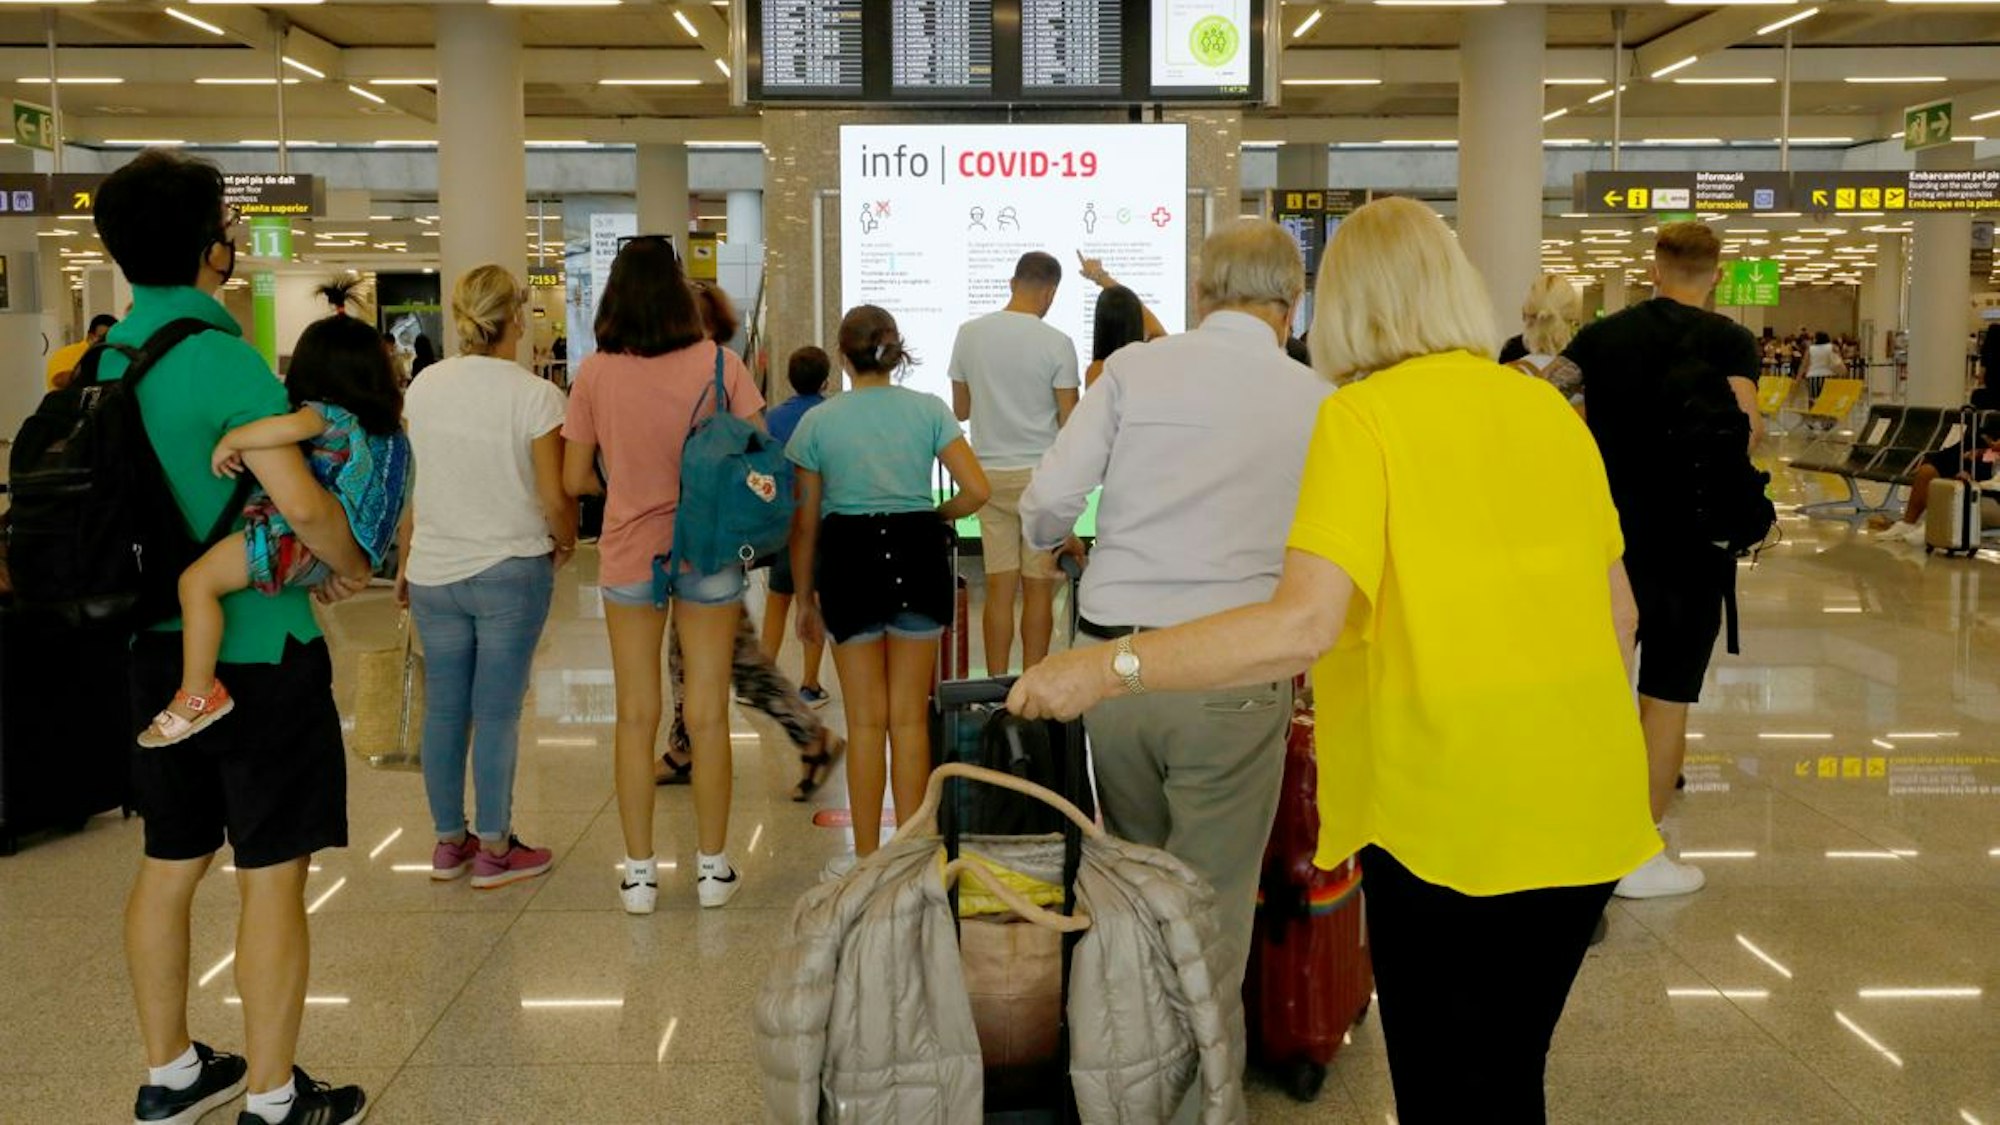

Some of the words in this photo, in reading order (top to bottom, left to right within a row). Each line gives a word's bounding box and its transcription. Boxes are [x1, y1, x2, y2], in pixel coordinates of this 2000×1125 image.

[862, 144, 929, 177] info
[958, 151, 1098, 178] COVID-19
[1696, 172, 1744, 181] Informació
[1909, 171, 1971, 181] Embarcament
[241, 204, 270, 214] planta
[271, 204, 309, 214] superior
[1696, 200, 1749, 210] Información
[1909, 200, 1953, 209] Embarque
